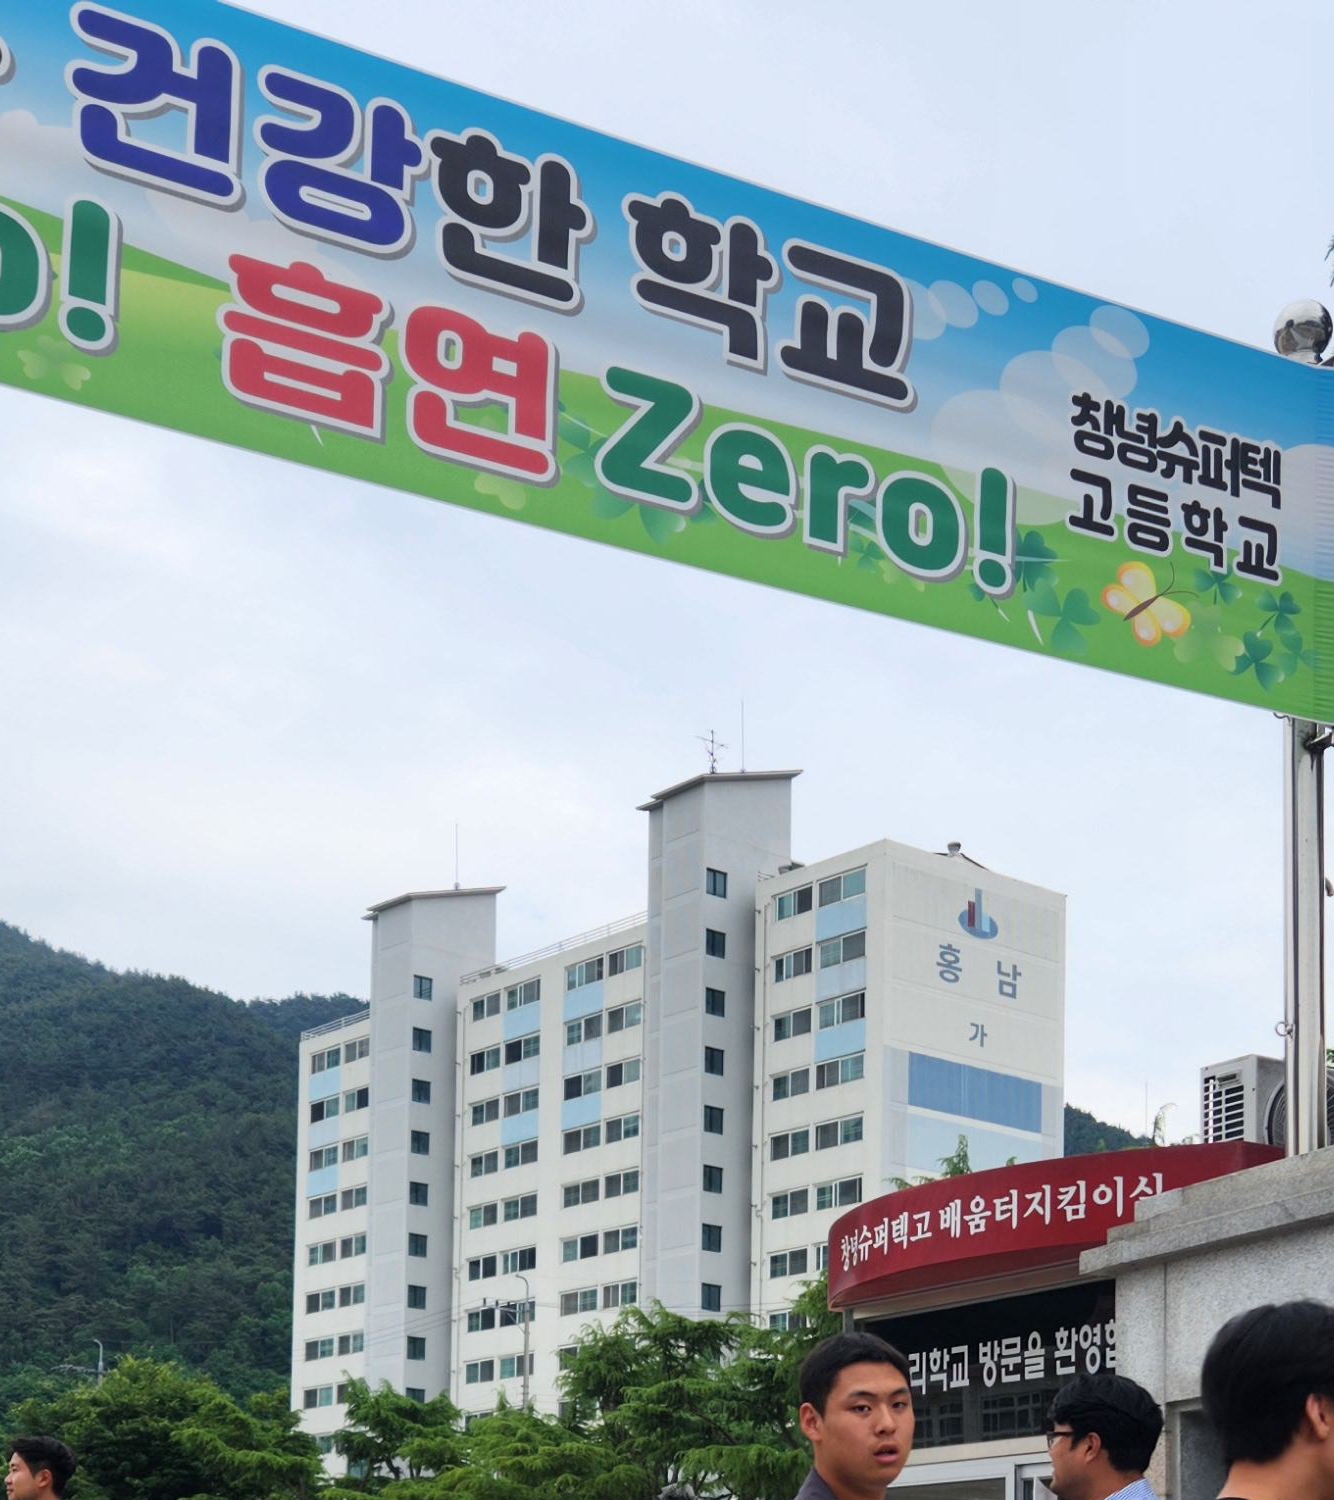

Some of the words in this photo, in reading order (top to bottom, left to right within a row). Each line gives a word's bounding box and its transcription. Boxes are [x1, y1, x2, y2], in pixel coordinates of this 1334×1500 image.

[73, 12, 586, 304] 건강한
[631, 195, 907, 403] 학교
[228, 257, 555, 477] 흡연
[599, 367, 1013, 590] Zero!
[1070, 391, 1282, 510] 창녕슈퍼텍
[1068, 467, 1280, 582] 고등학교
[968, 1021, 988, 1048] 가
[839, 1211, 934, 1271] 창녕슈퍼텍고
[978, 1330, 1046, 1388] 방문을
